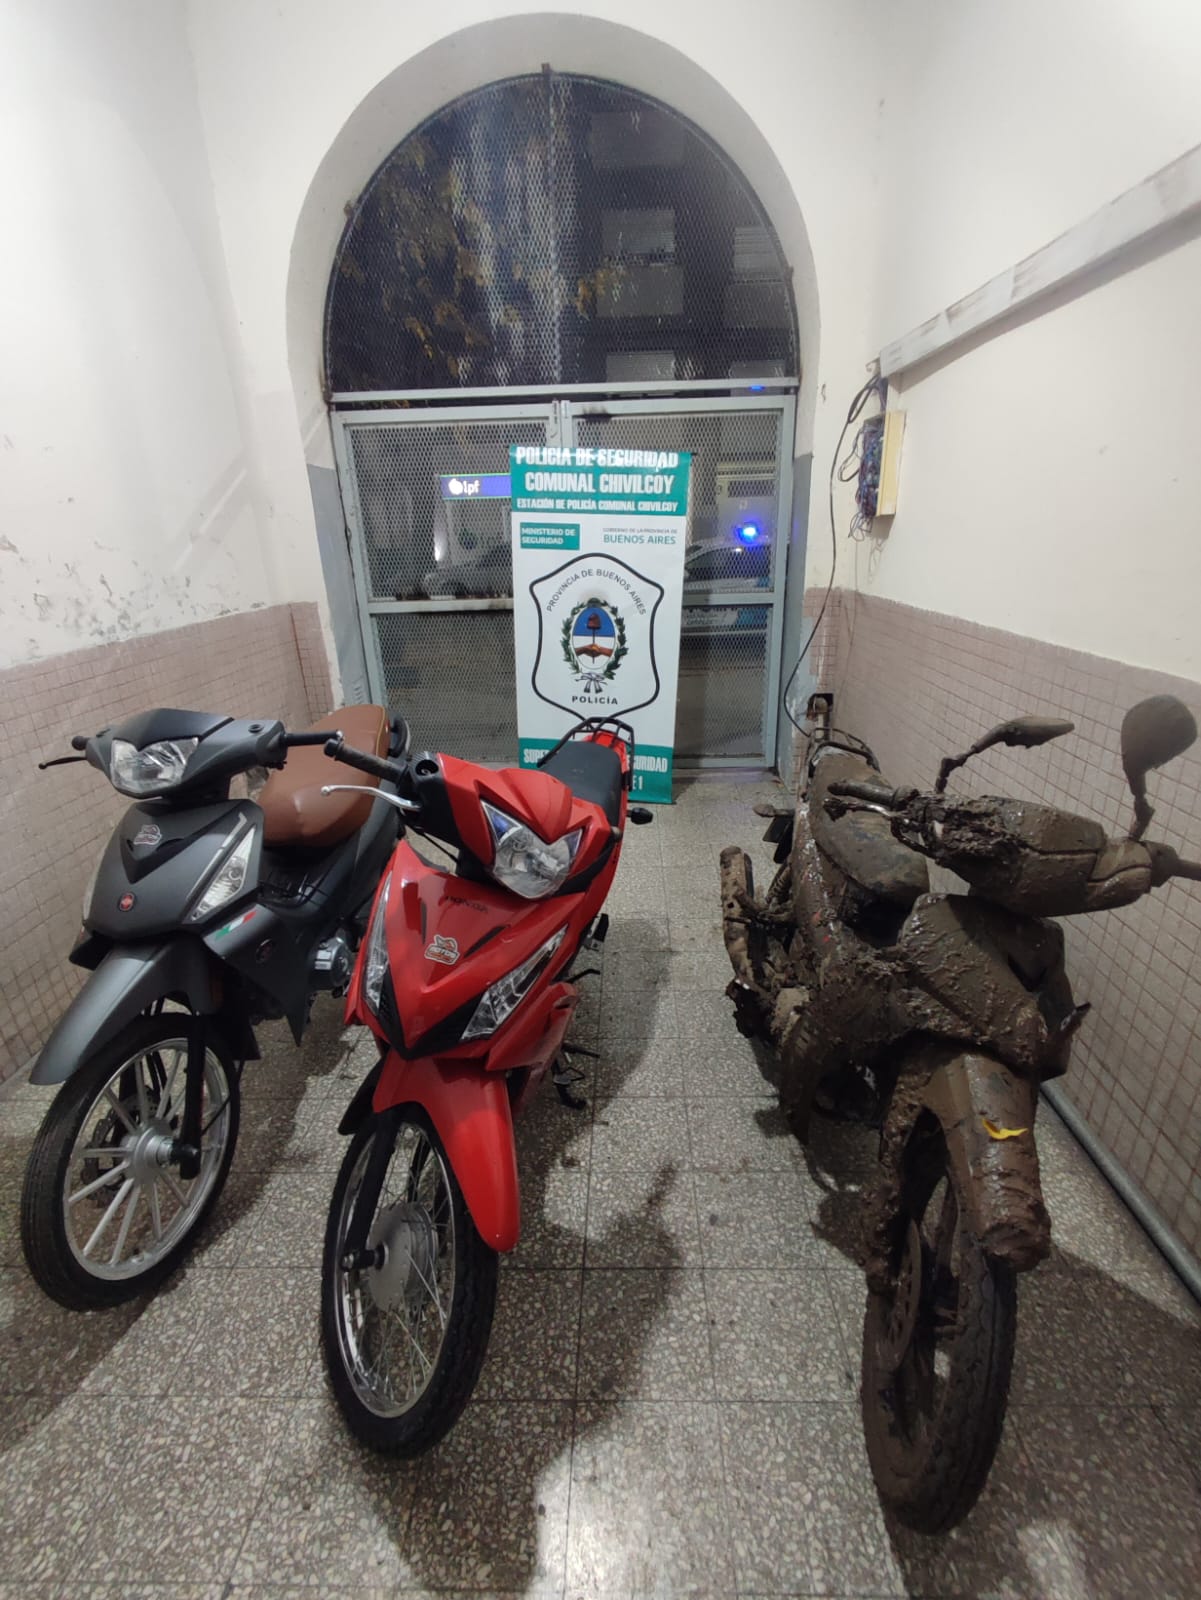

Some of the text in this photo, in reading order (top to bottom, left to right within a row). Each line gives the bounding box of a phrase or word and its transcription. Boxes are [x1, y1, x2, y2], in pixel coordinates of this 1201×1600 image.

[576, 448, 595, 466] DE
[597, 449, 679, 468] SEGURIDAD
[525, 472, 675, 495] COMUNAL CHIVILCOY
[517, 498, 554, 509] ESTACIÓN
[556, 500, 566, 509] DE
[598, 501, 636, 512] COMUNAL
[638, 502, 679, 513] CHIVILCOY
[521, 527, 576, 536] MINISTERIO DE
[521, 536, 564, 545] SEGURIDAD
[603, 534, 676, 545] BUENOS AIRES
[547, 568, 647, 616] PROVINCIA DE BUENOS AIRES
